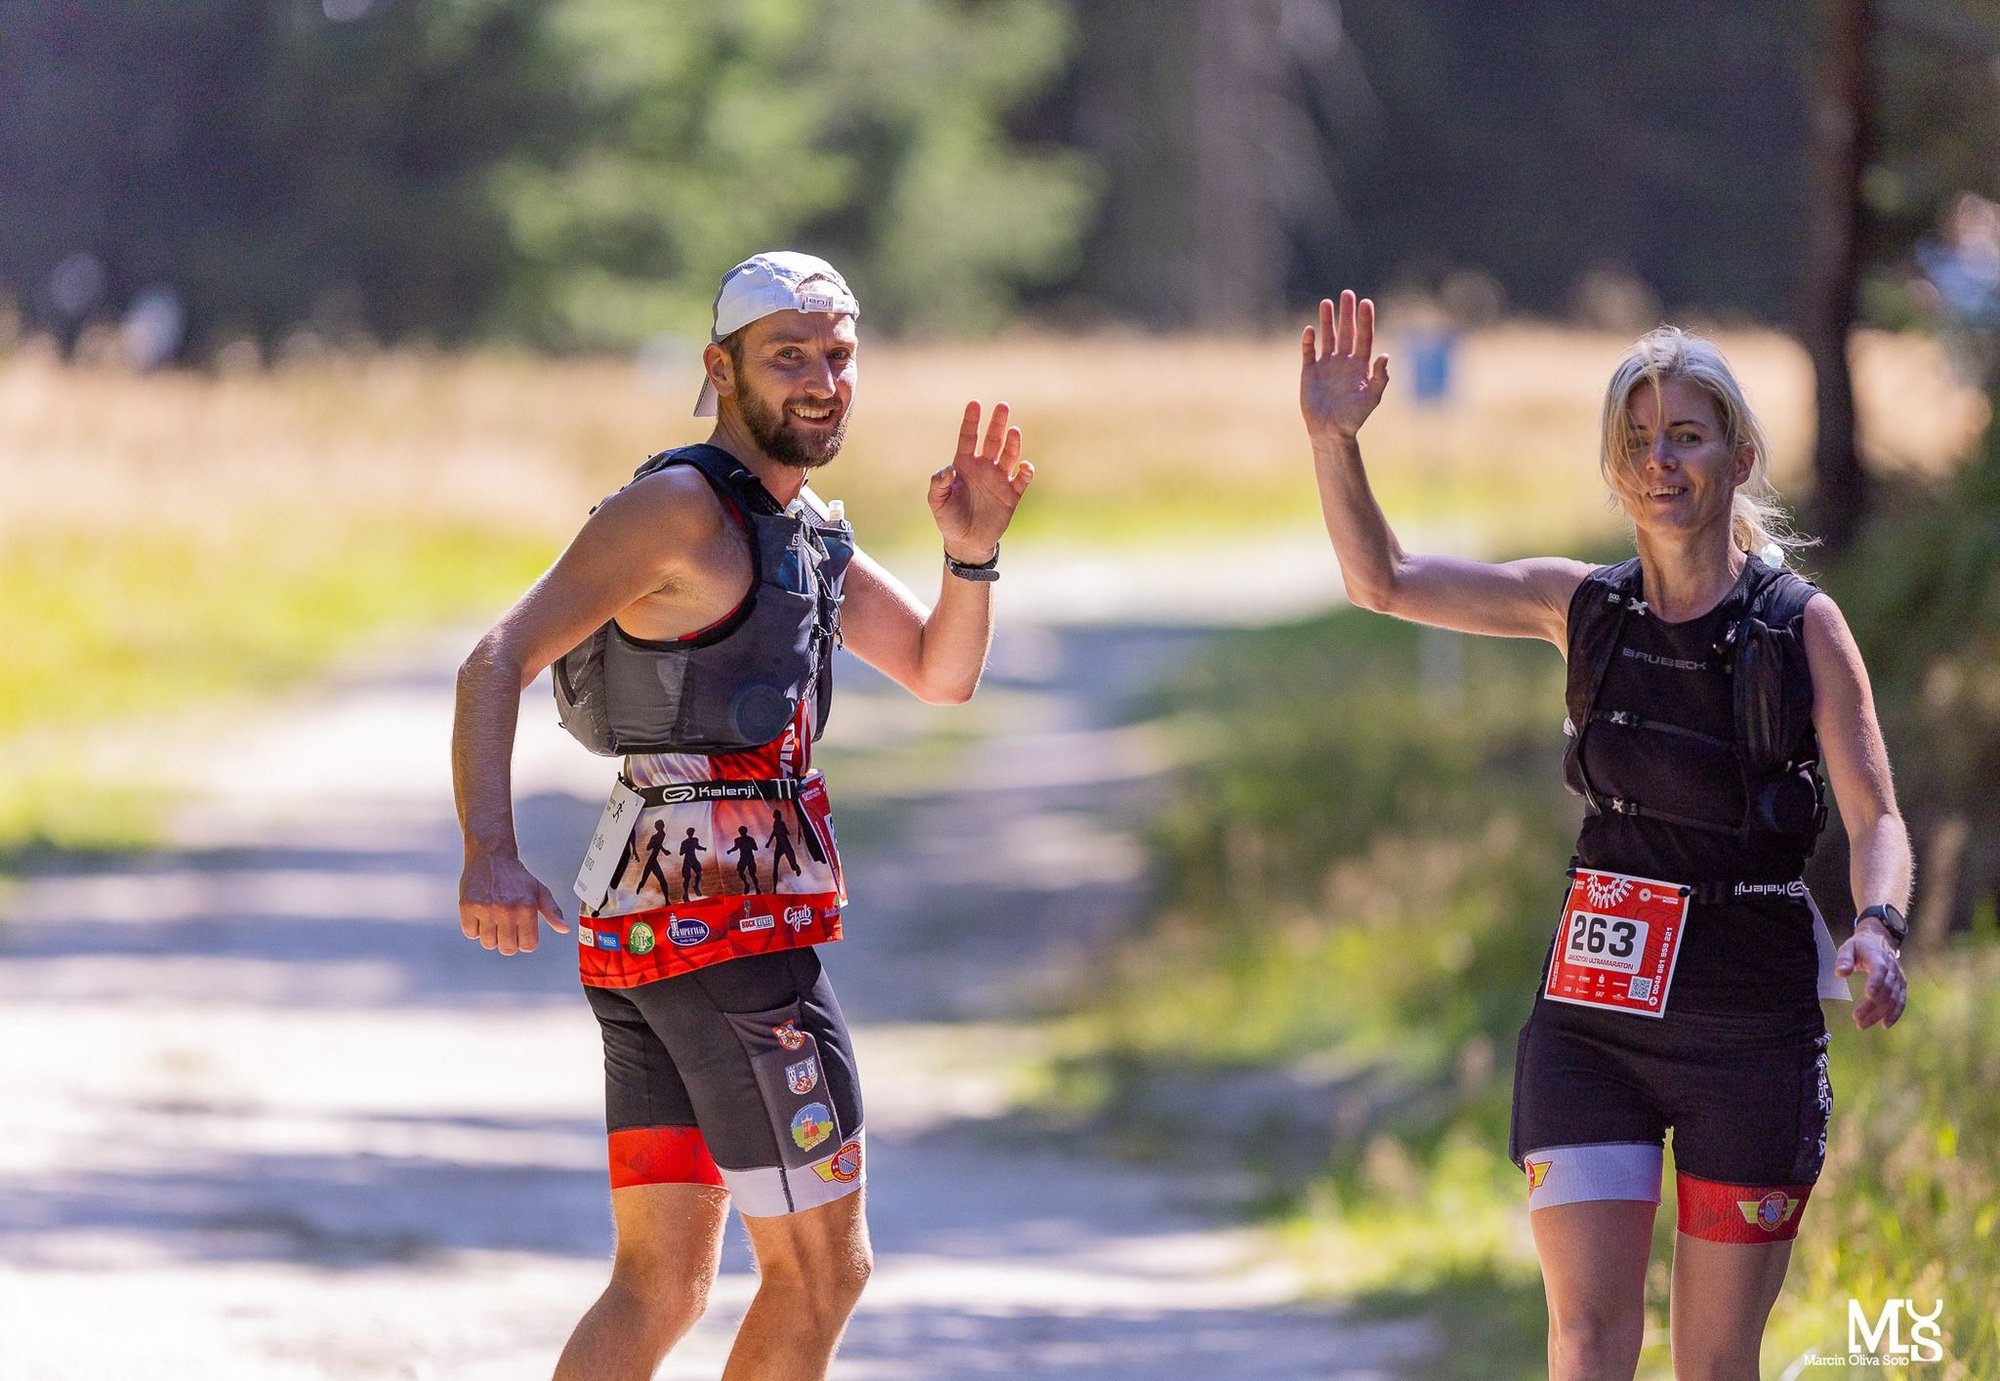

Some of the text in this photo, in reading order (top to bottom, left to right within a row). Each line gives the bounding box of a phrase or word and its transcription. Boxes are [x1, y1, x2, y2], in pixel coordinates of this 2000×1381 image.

[1622, 647, 1707, 670] BRUBECK
[699, 785, 755, 799] Kalenji
[1734, 881, 1786, 896] Kalenji
[1571, 914, 1637, 958] 263
[1588, 957, 1634, 970] ULTRAMARATON
